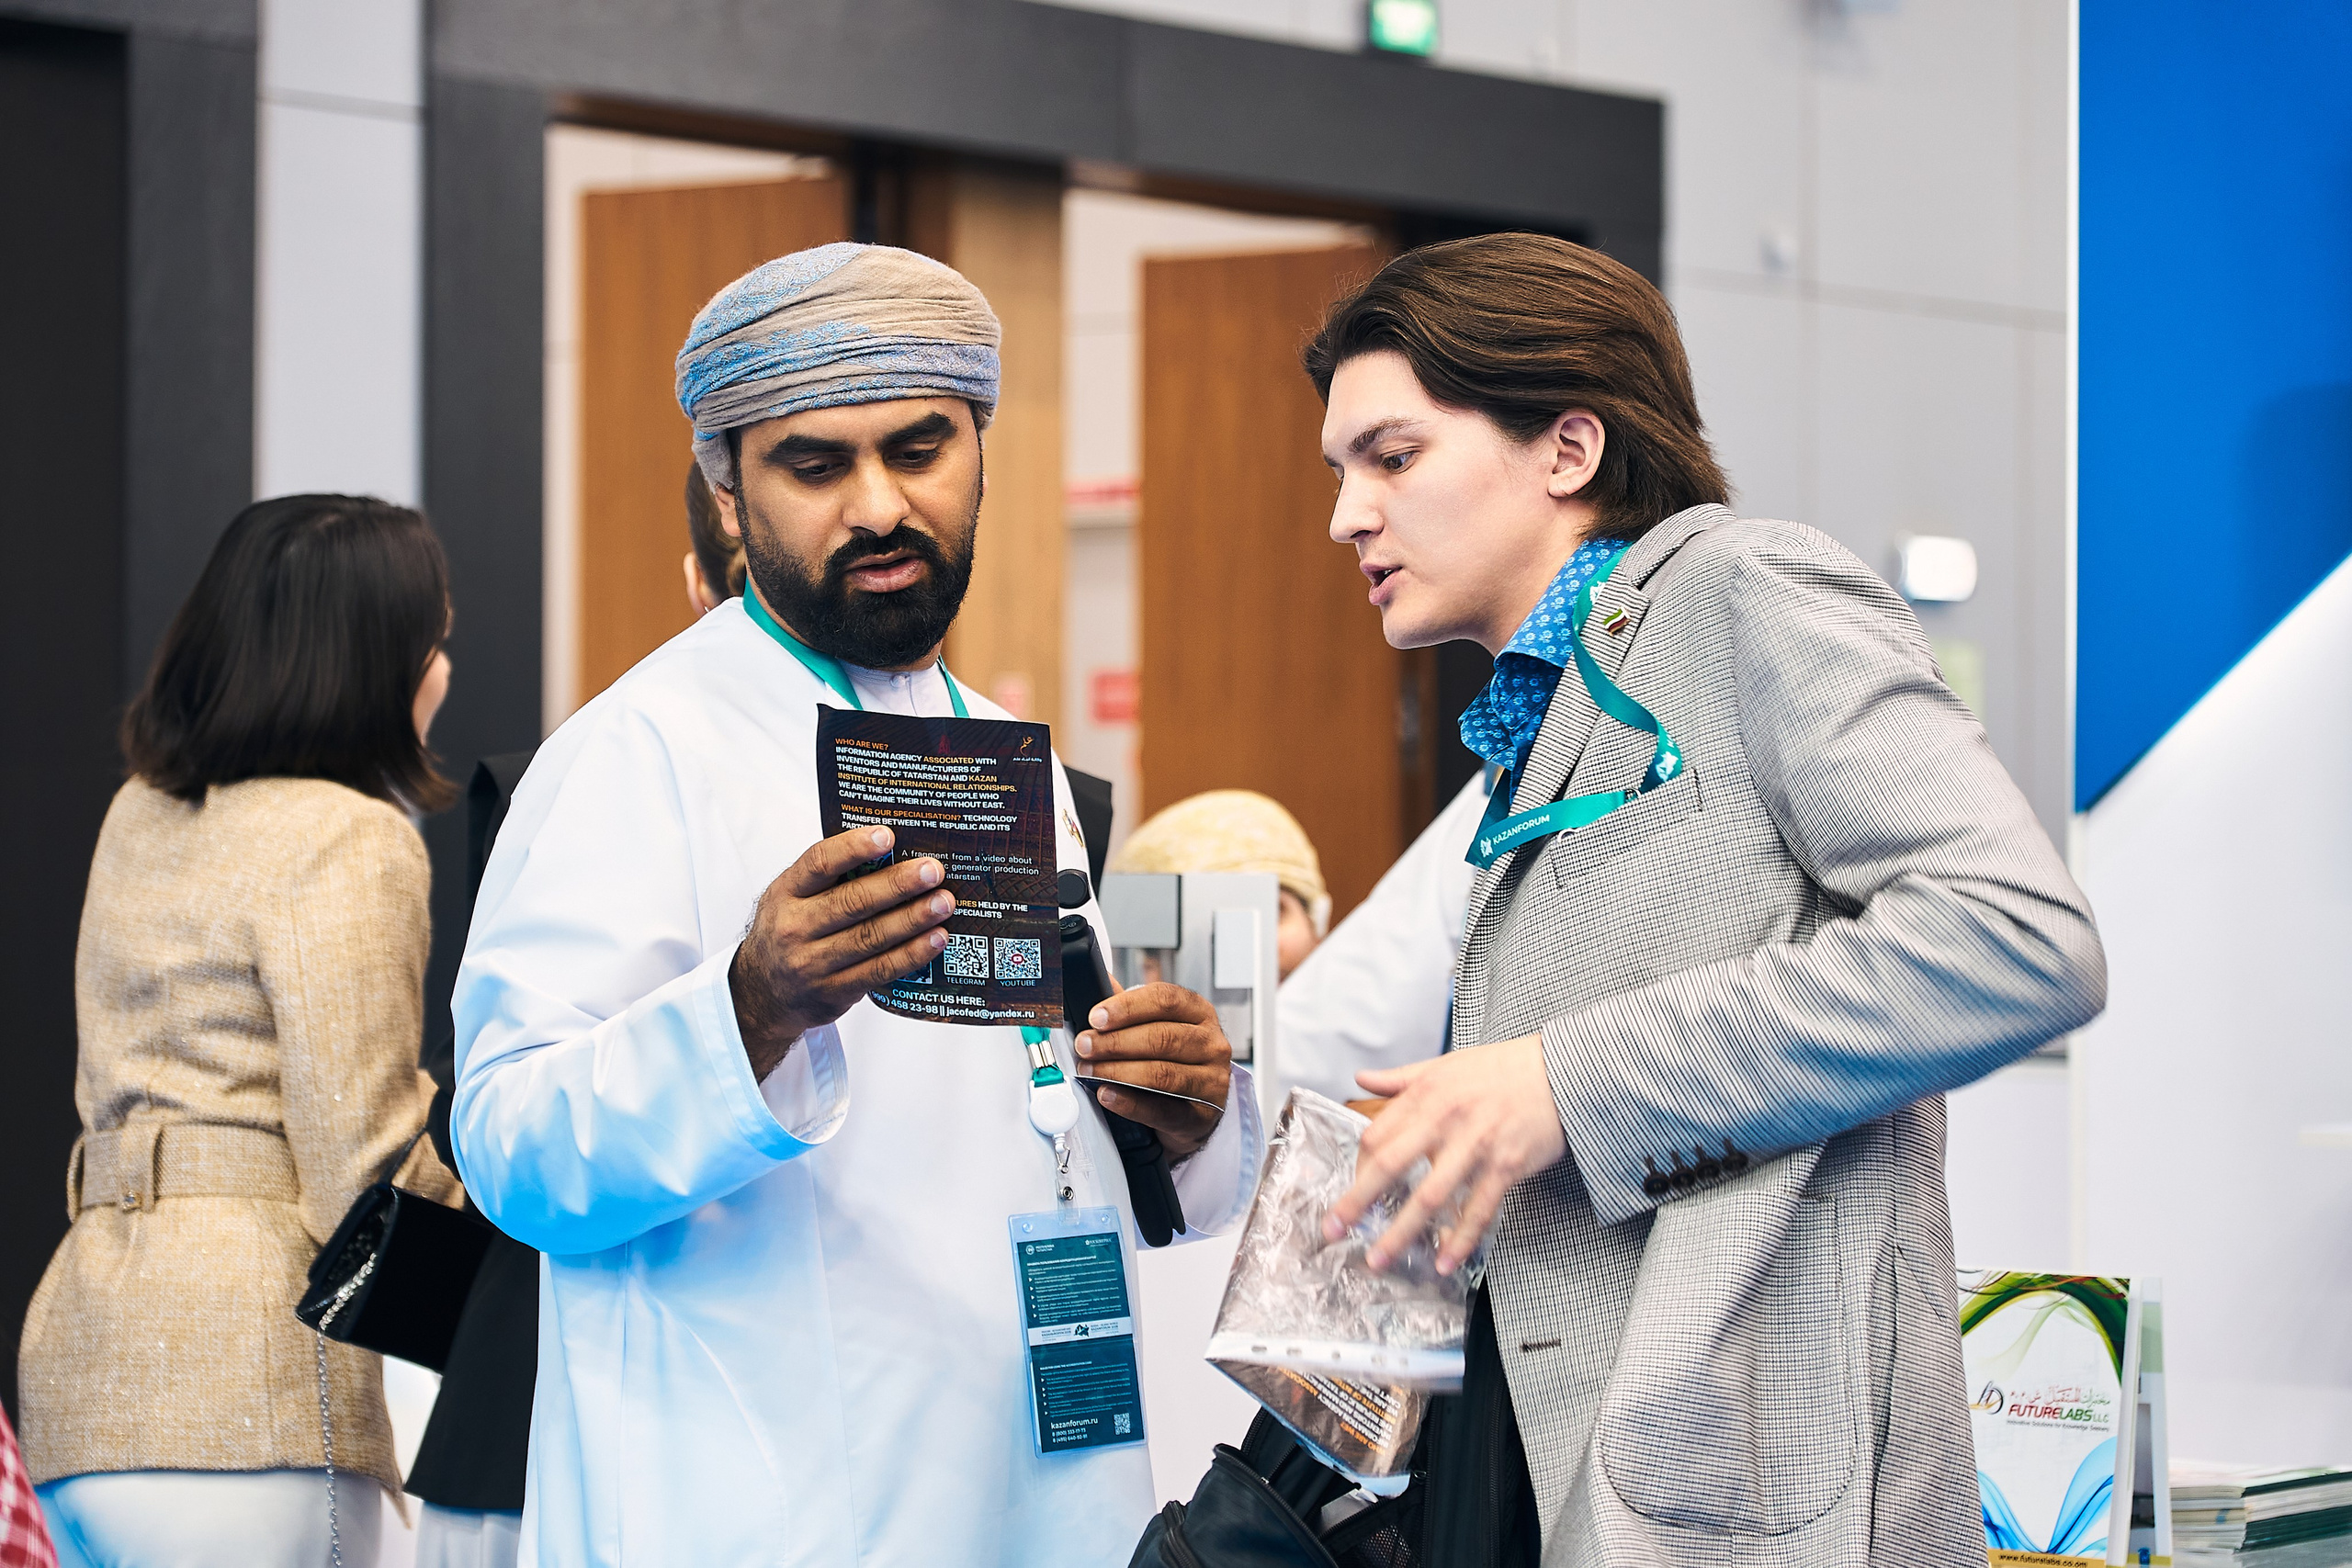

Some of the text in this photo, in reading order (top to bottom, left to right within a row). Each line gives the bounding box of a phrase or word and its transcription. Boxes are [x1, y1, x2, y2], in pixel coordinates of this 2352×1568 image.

[872, 742, 888, 750] WE?
[835, 747, 889, 760] INFORMATION
[890, 753, 922, 761] AGENCY
[836, 755, 879, 767] INVENTORS
[899, 762, 969, 773] MANUFACTURERS
[837, 763, 853, 772] THE
[854, 766, 889, 777] REPUBLIC
[903, 772, 949, 782] TATARSTAN
[838, 773, 876, 784] INSTITUTE
[889, 779, 952, 790] INTERNATIONAL
[953, 784, 1017, 792] RELATIONSHIPS.
[838, 781, 851, 789] WE
[884, 787, 933, 797] COMMUNITY
[839, 790, 862, 799] CAN'T
[863, 794, 895, 803] IMAGINE
[896, 796, 919, 805] THEIR
[842, 804, 864, 813] WHAT
[893, 810, 961, 820] SPECIALISATION?
[963, 815, 1017, 823] TECHNOLOGY
[842, 812, 880, 824] TRANSFER
[882, 818, 921, 827] BETWEEN
[940, 821, 978, 829] REPUBLIC
[1492, 814, 1550, 845] KAZANFORUM
[911, 851, 948, 860] fragment
[983, 854, 1006, 863] video
[1009, 856, 1032, 864] about
[952, 863, 991, 872] generator
[994, 865, 1039, 875] production
[946, 873, 980, 881] atarstan
[953, 908, 1002, 919] SPECIALISTS
[978, 901, 999, 909] HELD
[1012, 904, 1028, 912] THE
[946, 977, 985, 986] TELEGRAM
[892, 988, 986, 1006] CONTACT US HERE:
[891, 998, 908, 1010] 458
[910, 1003, 938, 1013] 23-98
[946, 1006, 1035, 1020] jacofed@yandex.ru
[1050, 1418, 1099, 1429] kazanforum.ru
